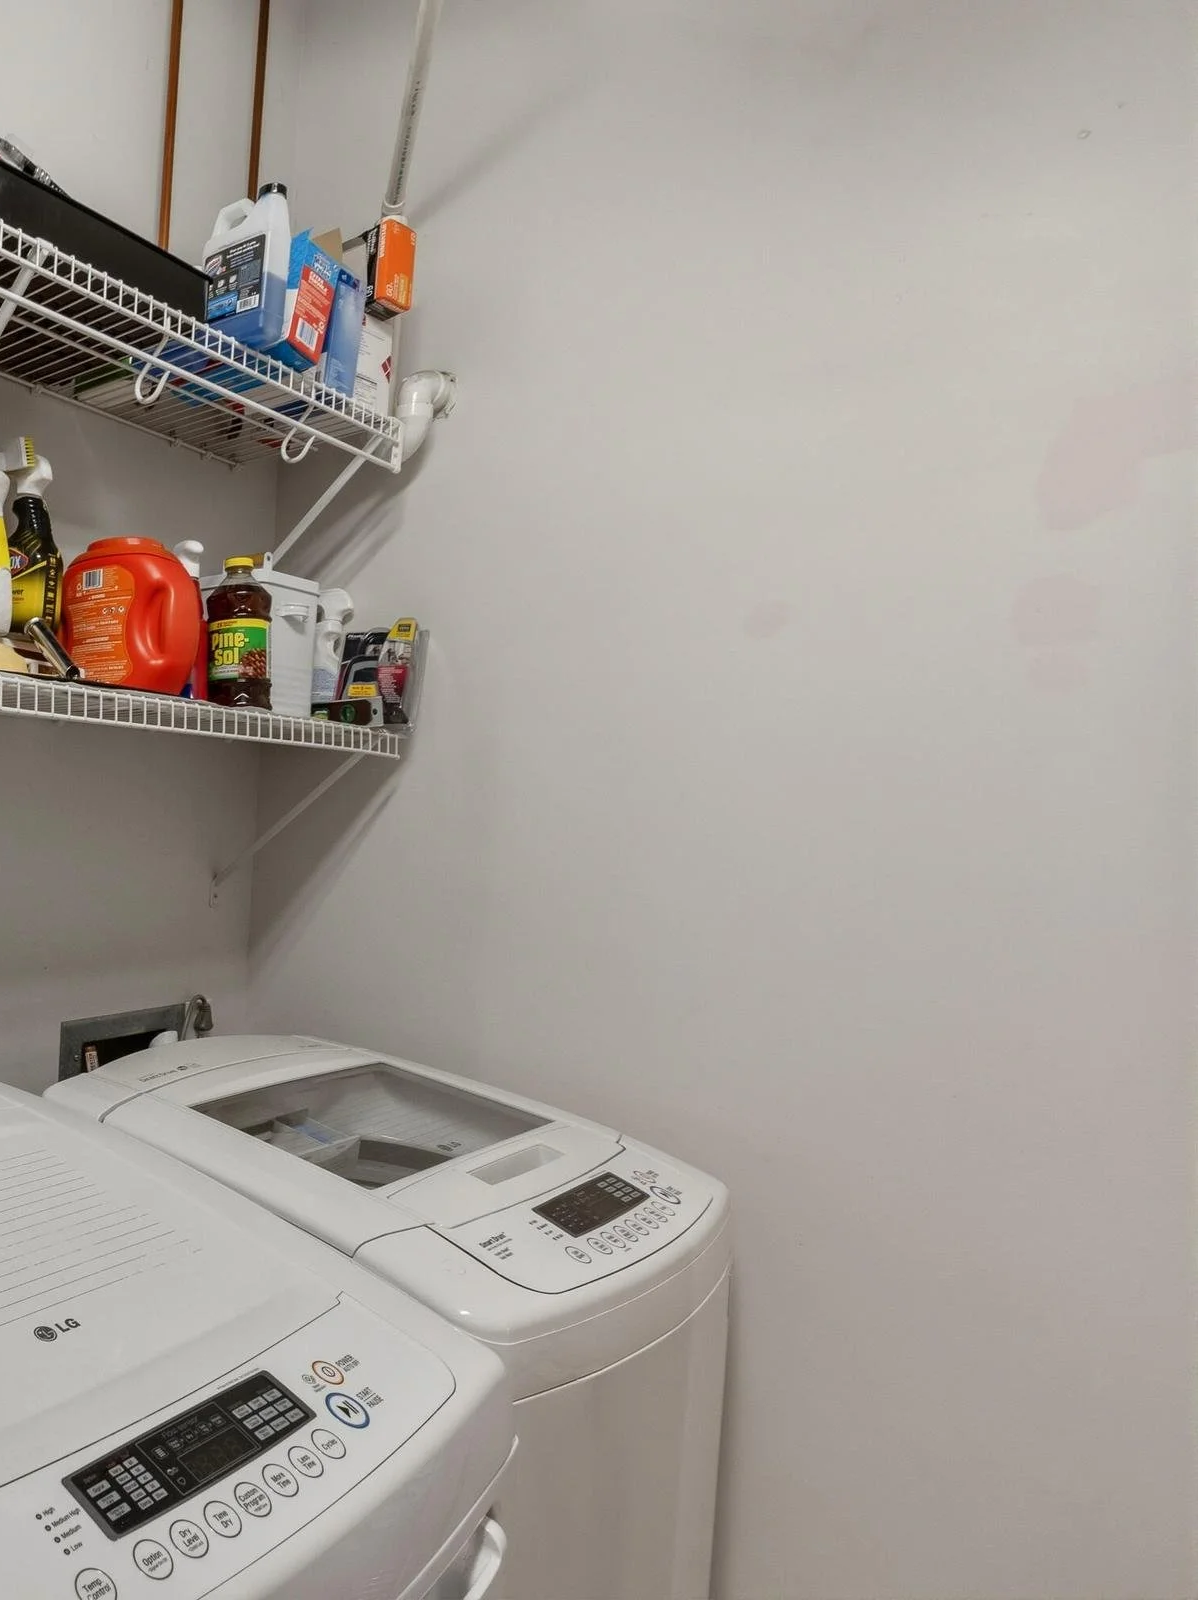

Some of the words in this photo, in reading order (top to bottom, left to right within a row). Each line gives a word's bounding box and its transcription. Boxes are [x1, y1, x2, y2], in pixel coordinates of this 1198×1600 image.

[212, 632, 250, 650] Pine-
[55, 1318, 81, 1333] LG
[356, 1386, 372, 1400] START
[366, 1394, 384, 1408] PAUSE
[302, 1460, 317, 1470] Time
[270, 1472, 285, 1483] More
[277, 1479, 291, 1489] Time
[238, 1488, 259, 1502] Custom
[242, 1493, 266, 1510] Program
[213, 1510, 229, 1521] Time
[221, 1518, 234, 1529] Dry
[178, 1528, 192, 1538] Dry
[182, 1533, 201, 1547] Level
[71, 1542, 83, 1552] Low
[142, 1550, 164, 1567] Option
